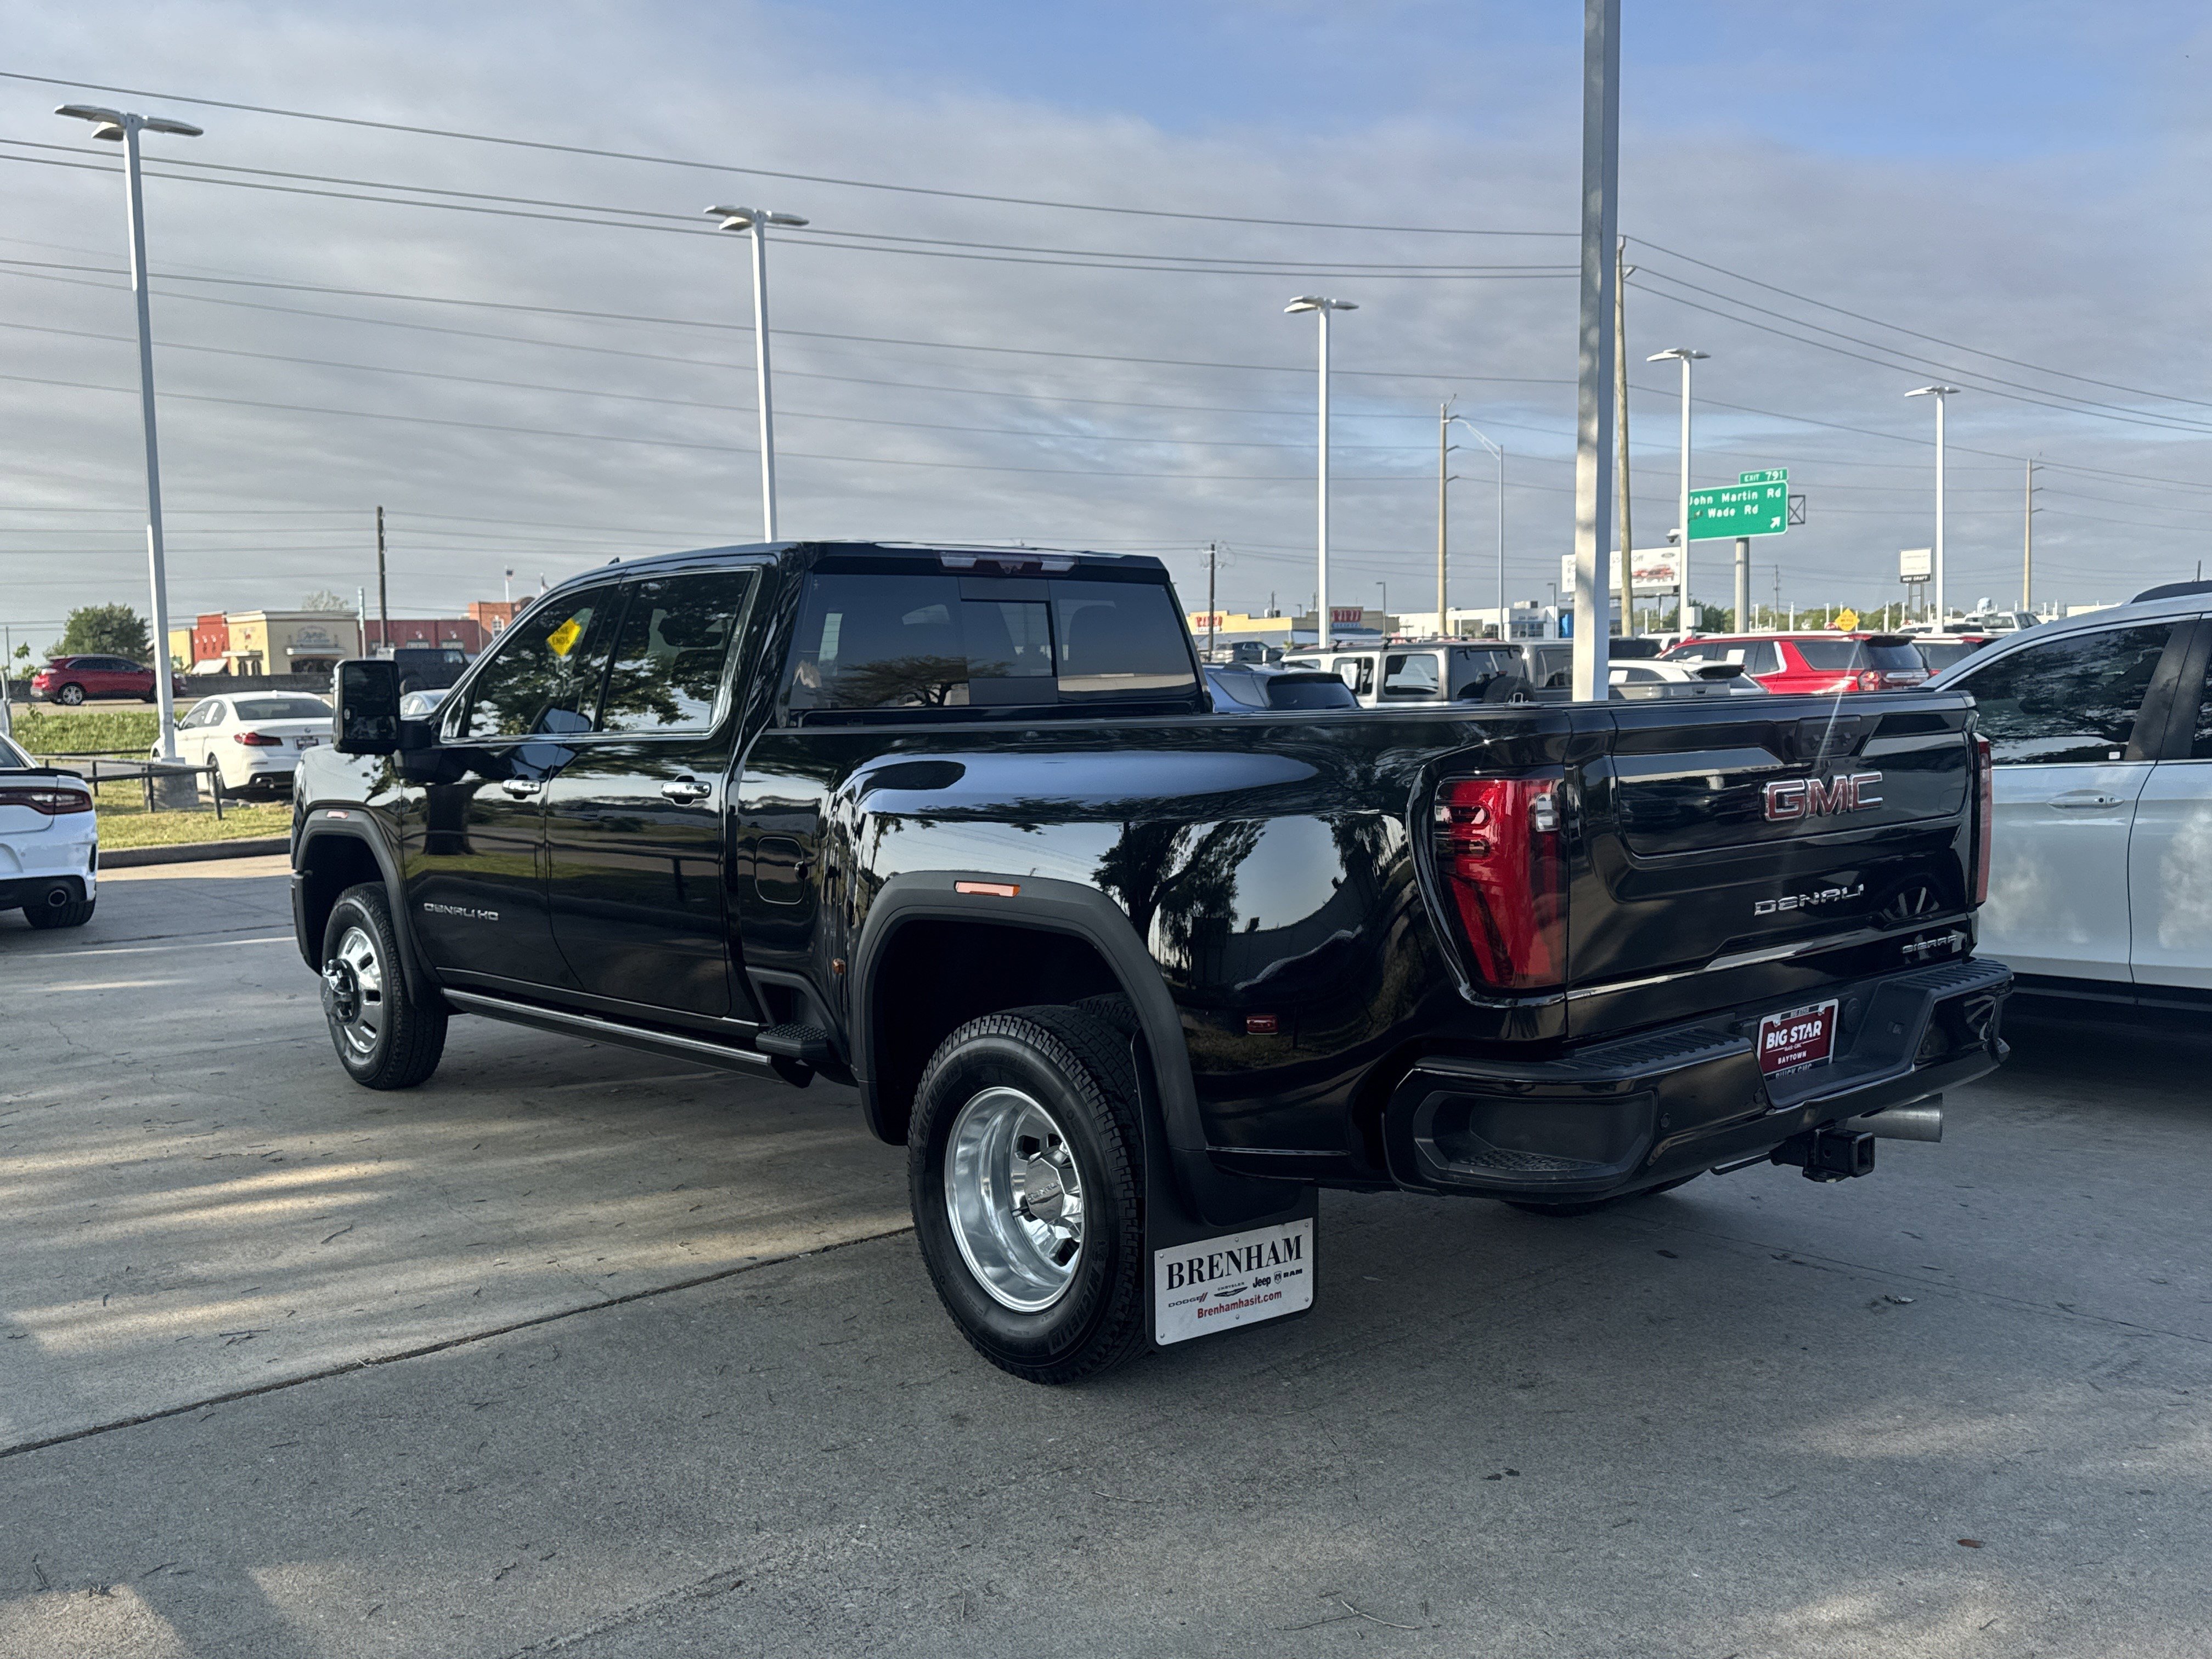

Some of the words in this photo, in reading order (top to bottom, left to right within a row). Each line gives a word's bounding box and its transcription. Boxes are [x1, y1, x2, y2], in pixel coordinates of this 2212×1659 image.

[1744, 474, 1760, 482] EXIT
[1765, 470, 1783, 481] 791
[1689, 495, 1713, 506] John
[1722, 490, 1758, 503] Martin
[1767, 487, 1781, 499] Rd
[1708, 507, 1736, 518] Wade
[1744, 504, 1759, 515] Rd
[1763, 770, 1884, 822] GMC
[424, 902, 476, 919] DENALI
[477, 909, 499, 921] HD
[1754, 883, 1864, 917] DENALI
[1902, 934, 1958, 954] SIERRA
[1765, 1029, 1788, 1049] BIG
[1790, 1020, 1822, 1043] STAR
[1778, 1051, 1807, 1065] BAYTOWN
[1166, 1234, 1303, 1290] BRENHAM
[1168, 1295, 1201, 1308] DODGE
[1252, 1276, 1272, 1289] Jeep
[1283, 1268, 1303, 1278] RAM
[1198, 1290, 1282, 1319] Brenhamhasit.com
